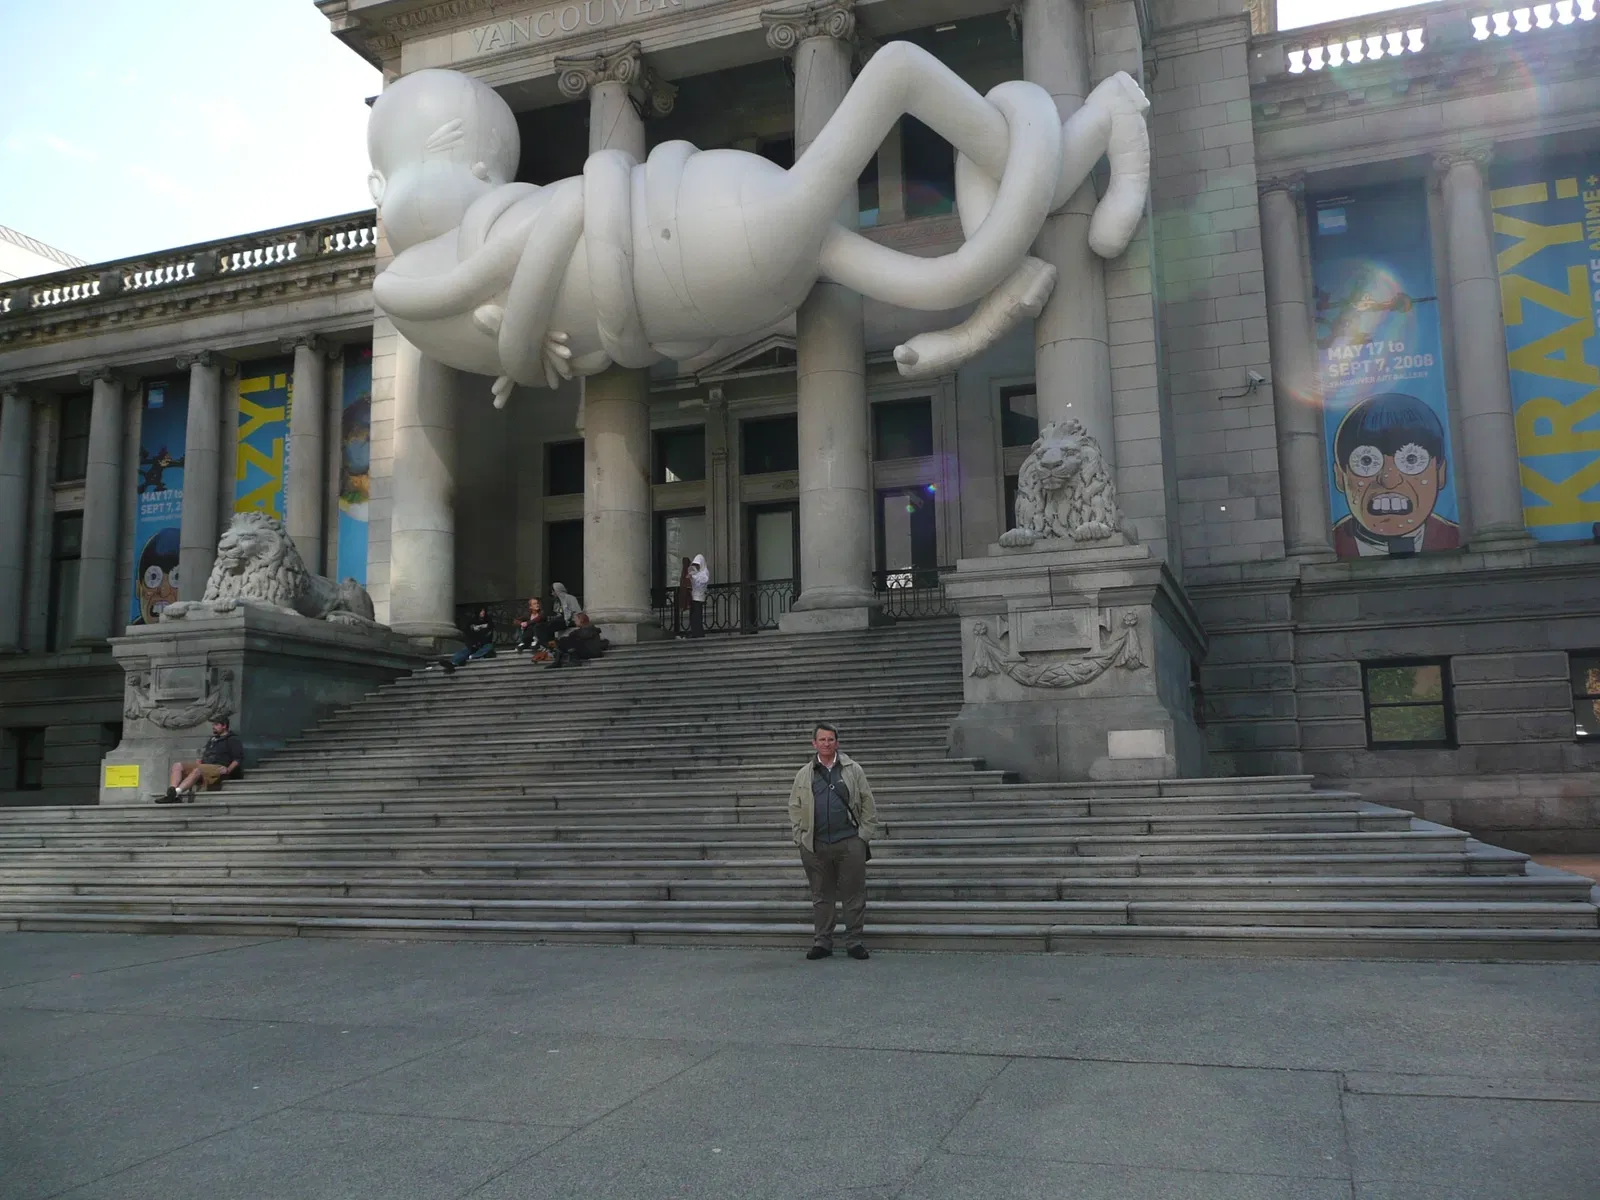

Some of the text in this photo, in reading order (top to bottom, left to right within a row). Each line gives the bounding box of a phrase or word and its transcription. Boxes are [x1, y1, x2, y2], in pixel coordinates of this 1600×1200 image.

[1327, 340, 1405, 360] MAY 17 to
[1491, 178, 1600, 527] KRAZY!
[1328, 353, 1434, 377] SEPT 7, 2008
[142, 491, 161, 502] MAY
[163, 490, 173, 500] 17
[141, 503, 164, 515] SEPT
